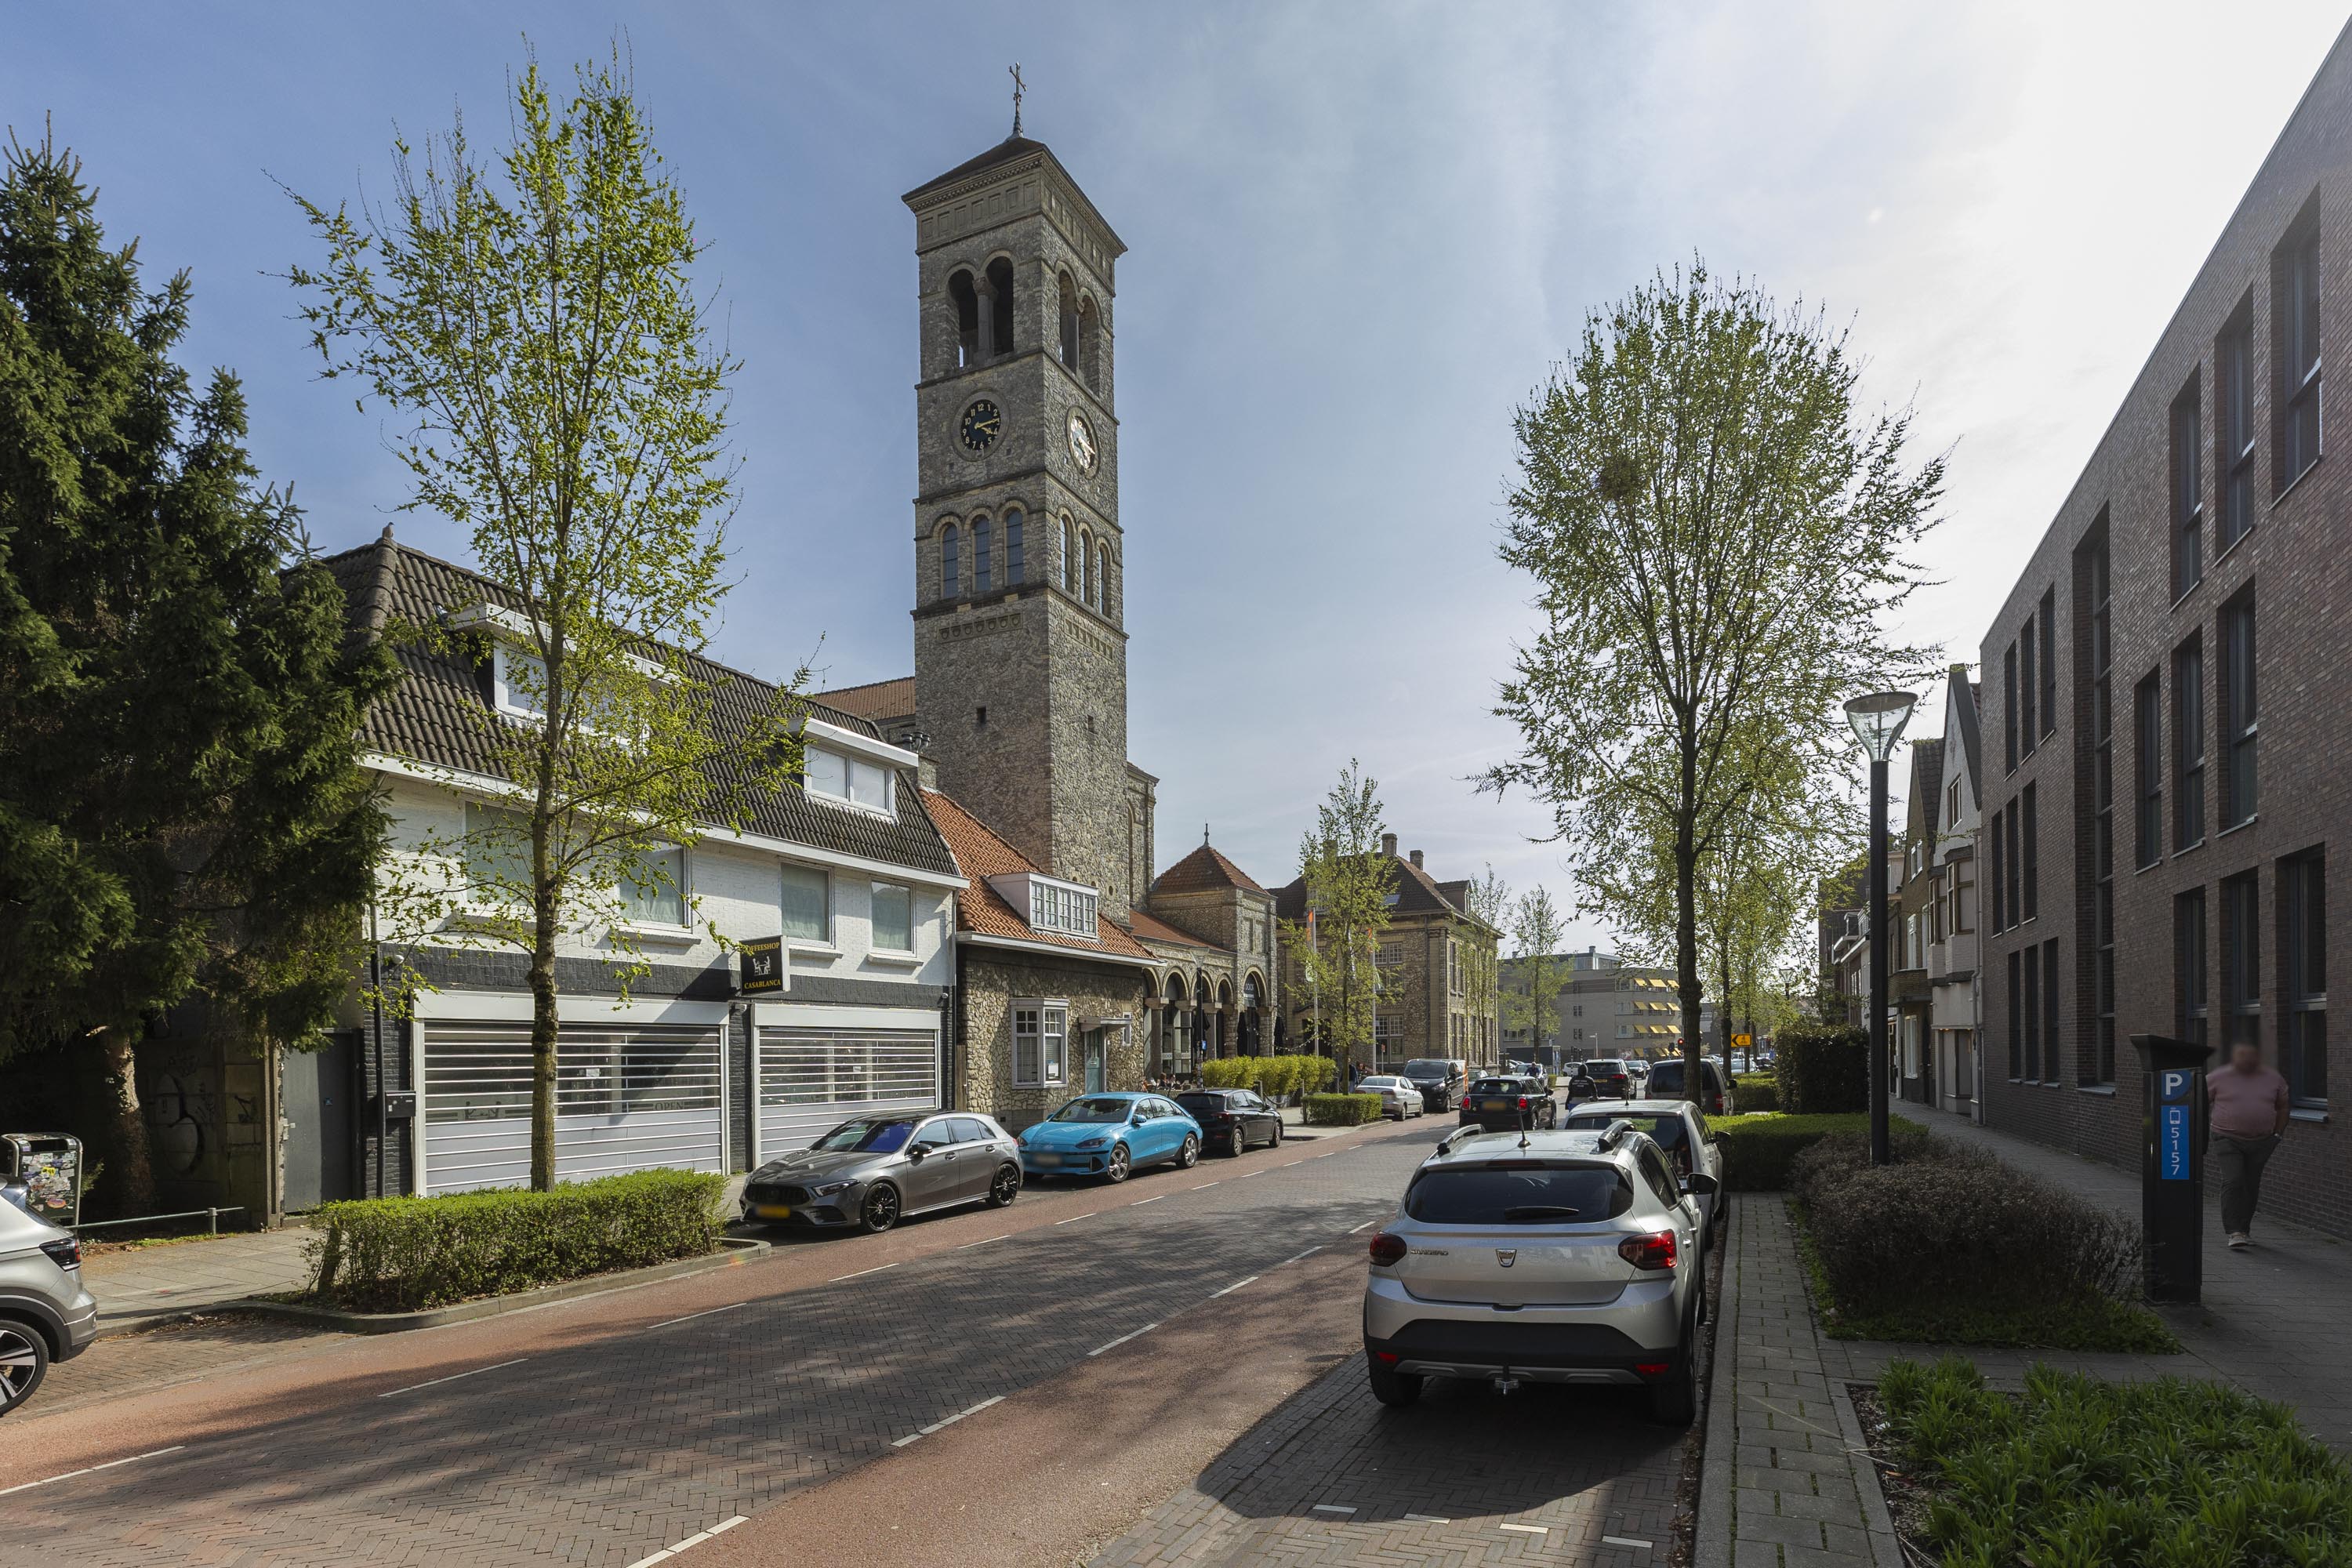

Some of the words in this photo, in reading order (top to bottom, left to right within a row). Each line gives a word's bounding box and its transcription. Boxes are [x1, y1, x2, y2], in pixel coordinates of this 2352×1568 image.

[965, 417, 971, 426] 10
[744, 942, 780, 953] OFFEESHOP
[744, 979, 781, 989] CASABLANCA
[2165, 1073, 2183, 1095] P
[655, 1101, 684, 1111] OPEN
